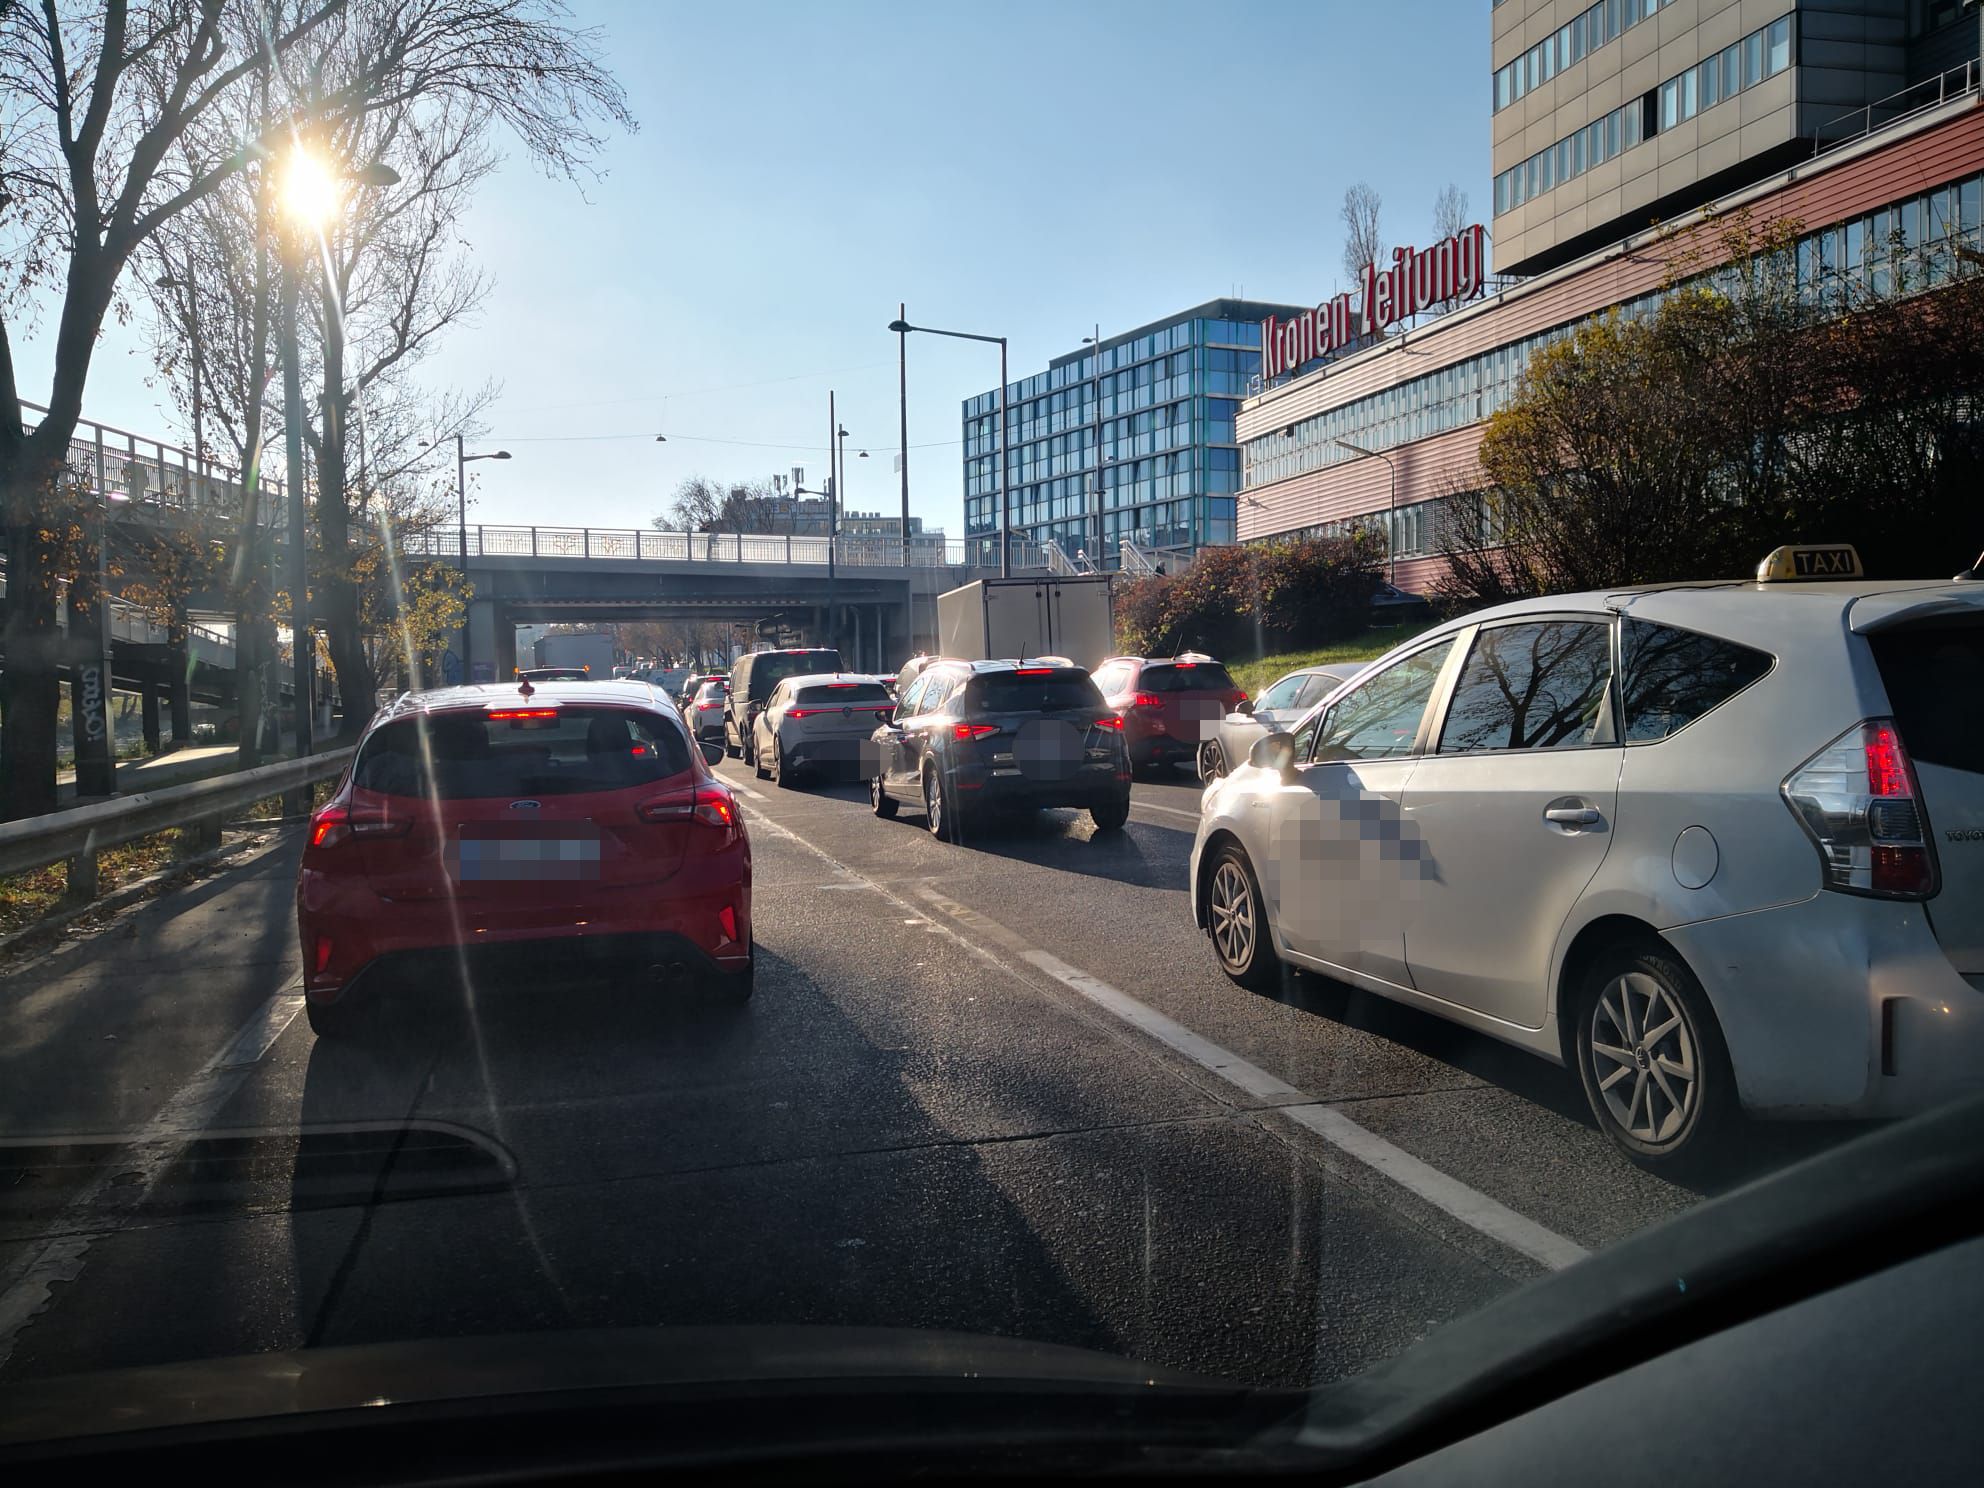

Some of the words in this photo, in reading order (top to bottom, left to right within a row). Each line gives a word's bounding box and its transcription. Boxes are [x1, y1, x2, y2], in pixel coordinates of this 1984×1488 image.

[1261, 293, 1350, 381] Kronen
[1359, 223, 1481, 336] Zeitung
[1797, 551, 1850, 573] TAXI
